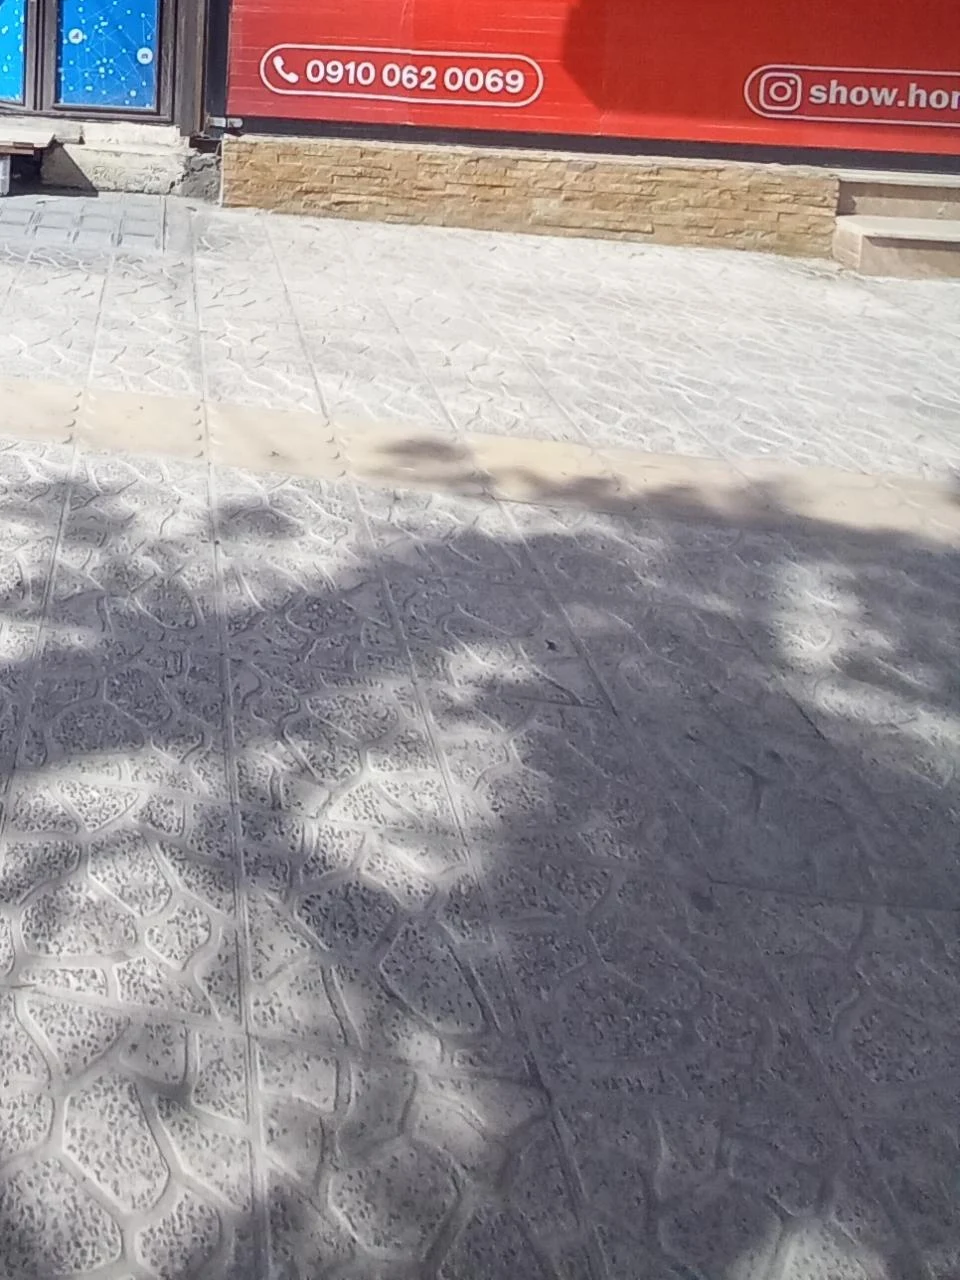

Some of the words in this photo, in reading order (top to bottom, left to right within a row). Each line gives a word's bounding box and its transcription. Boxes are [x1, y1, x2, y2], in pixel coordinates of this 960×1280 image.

[306, 59, 376, 86] 0910
[382, 63, 437, 91] 062
[443, 67, 525, 94] 0069
